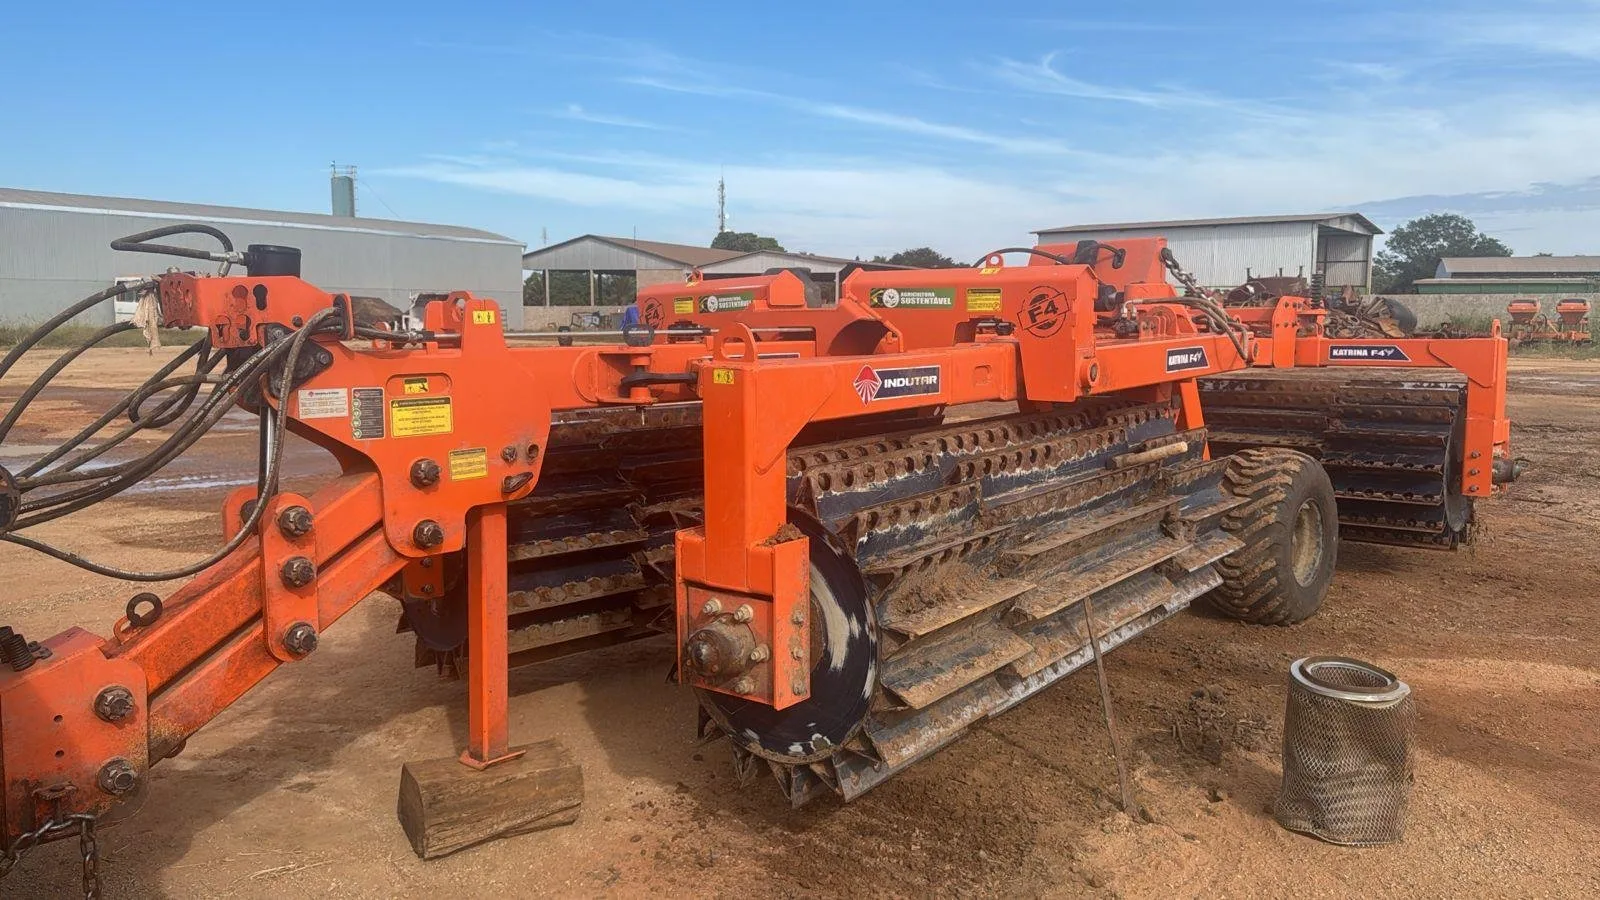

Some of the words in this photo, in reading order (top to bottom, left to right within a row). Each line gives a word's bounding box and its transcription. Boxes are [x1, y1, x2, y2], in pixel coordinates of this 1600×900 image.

[900, 296, 952, 305] SUSTENTÁVEL
[1028, 300, 1059, 323] F4
[1332, 349, 1368, 357] KATRINA
[1168, 354, 1189, 366] KATRINA
[884, 375, 938, 389] INDUTAR
